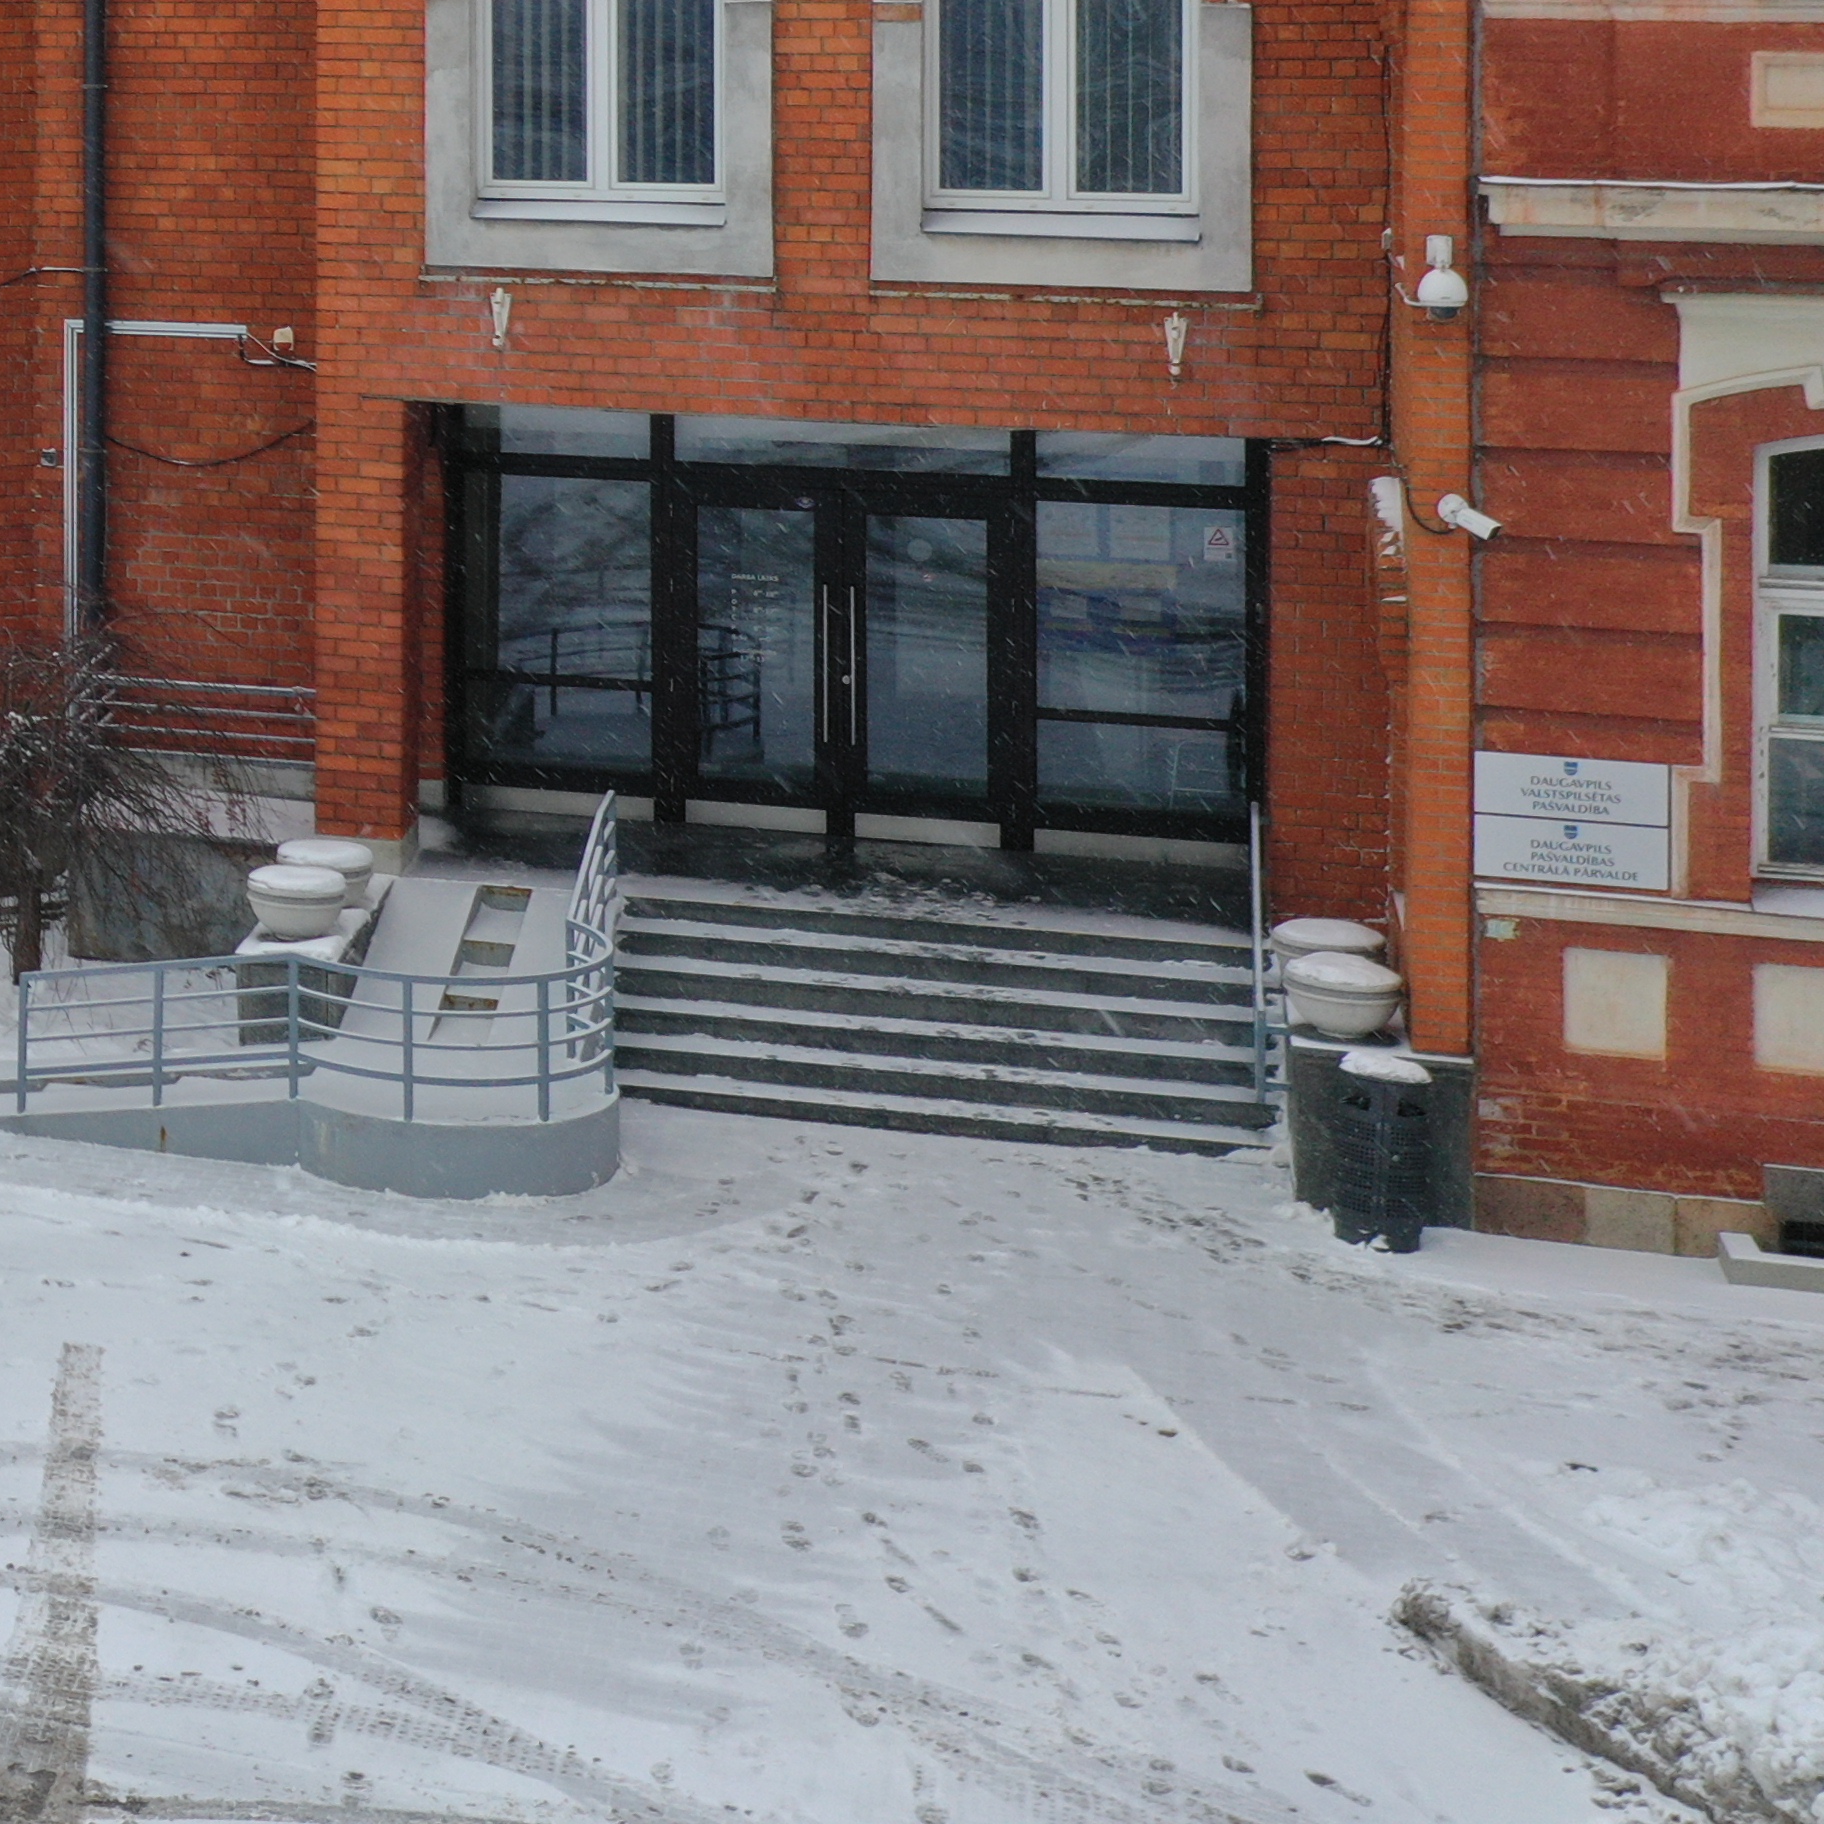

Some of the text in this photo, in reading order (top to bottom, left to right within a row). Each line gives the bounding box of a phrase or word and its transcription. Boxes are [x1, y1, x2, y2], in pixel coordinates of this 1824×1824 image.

[1530, 776, 1611, 790] DAUGAVPILS
[1521, 788, 1621, 804] VALSTSPILSĒTAS
[1532, 801, 1610, 815] PAŠVALDĪBA
[1530, 839, 1611, 854] DAUGAVPILS
[1531, 852, 1615, 866] PAŠVALDĪBAS
[1503, 862, 1638, 881] CENTRĀLĀ PĀRVALDE
